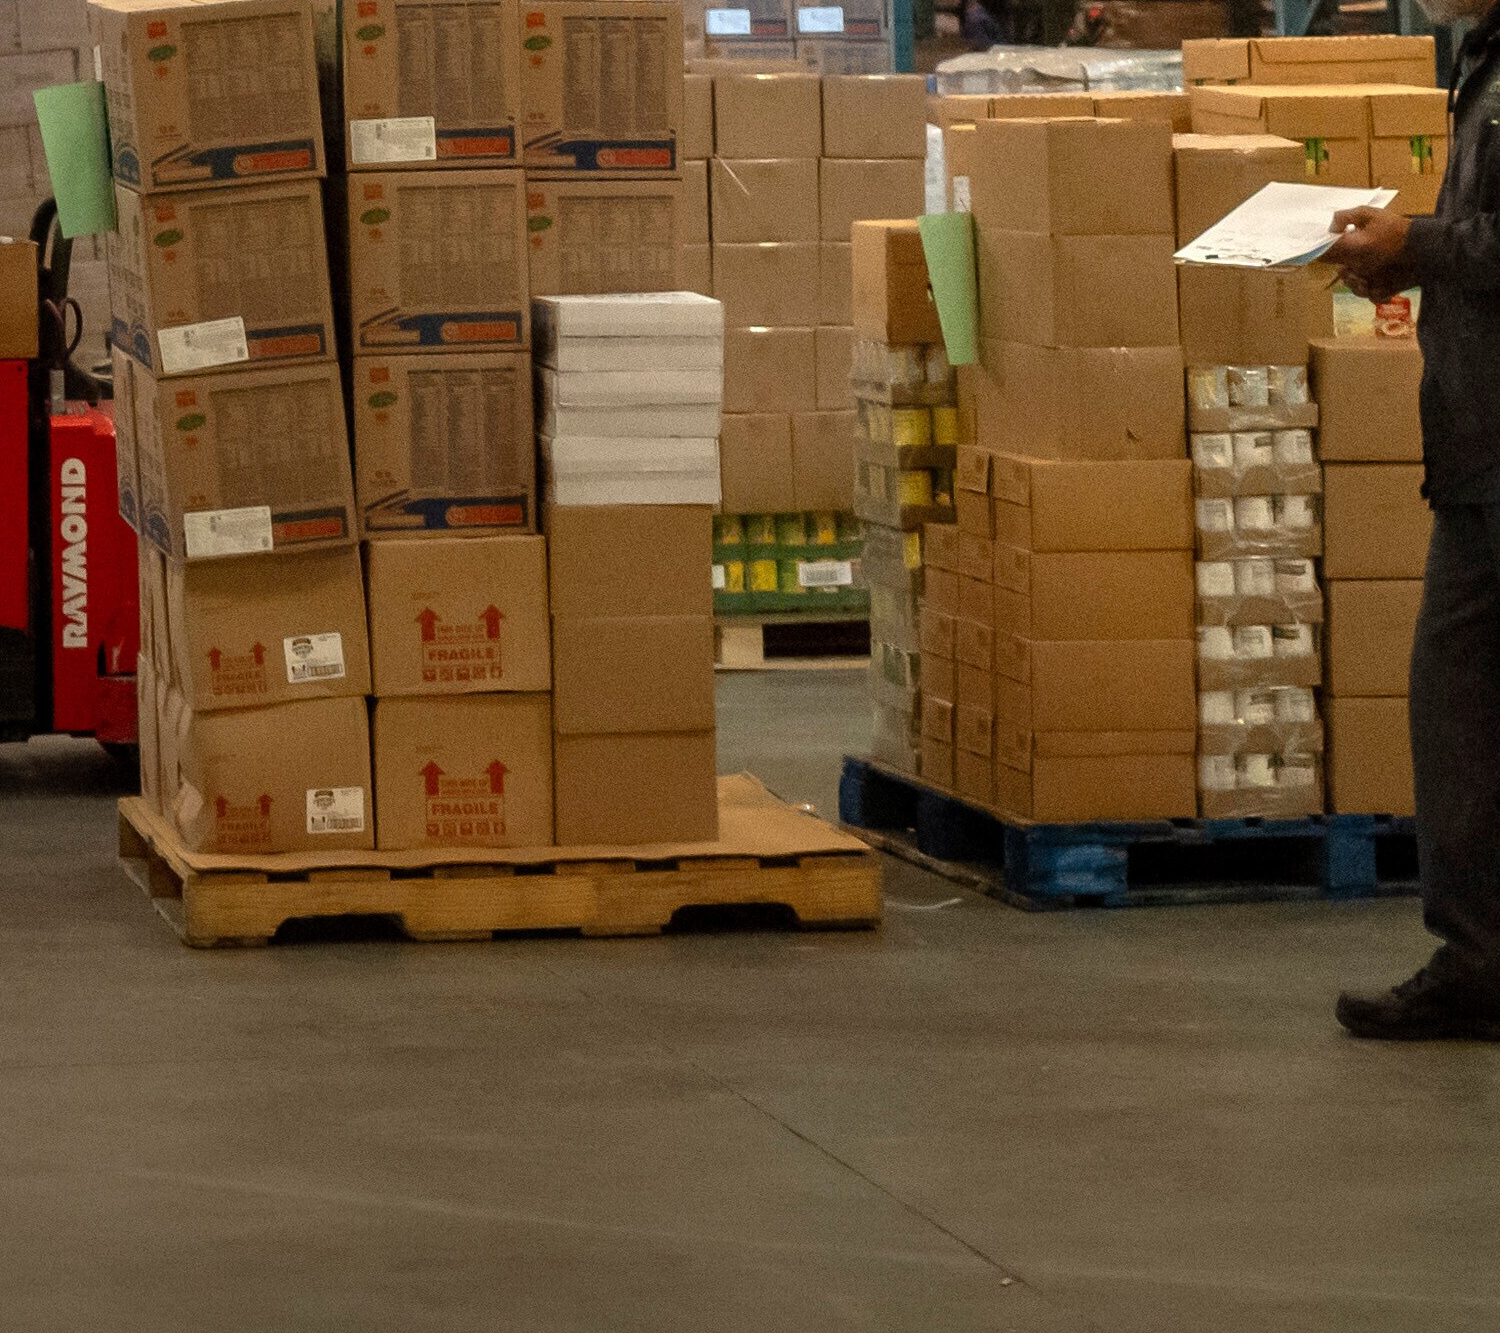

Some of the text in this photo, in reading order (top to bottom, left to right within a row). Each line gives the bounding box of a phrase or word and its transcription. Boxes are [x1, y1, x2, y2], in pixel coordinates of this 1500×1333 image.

[62, 457, 88, 649] RAYMOND
[428, 647, 495, 662] FRAGILE
[431, 803, 499, 815] FRAGILE
